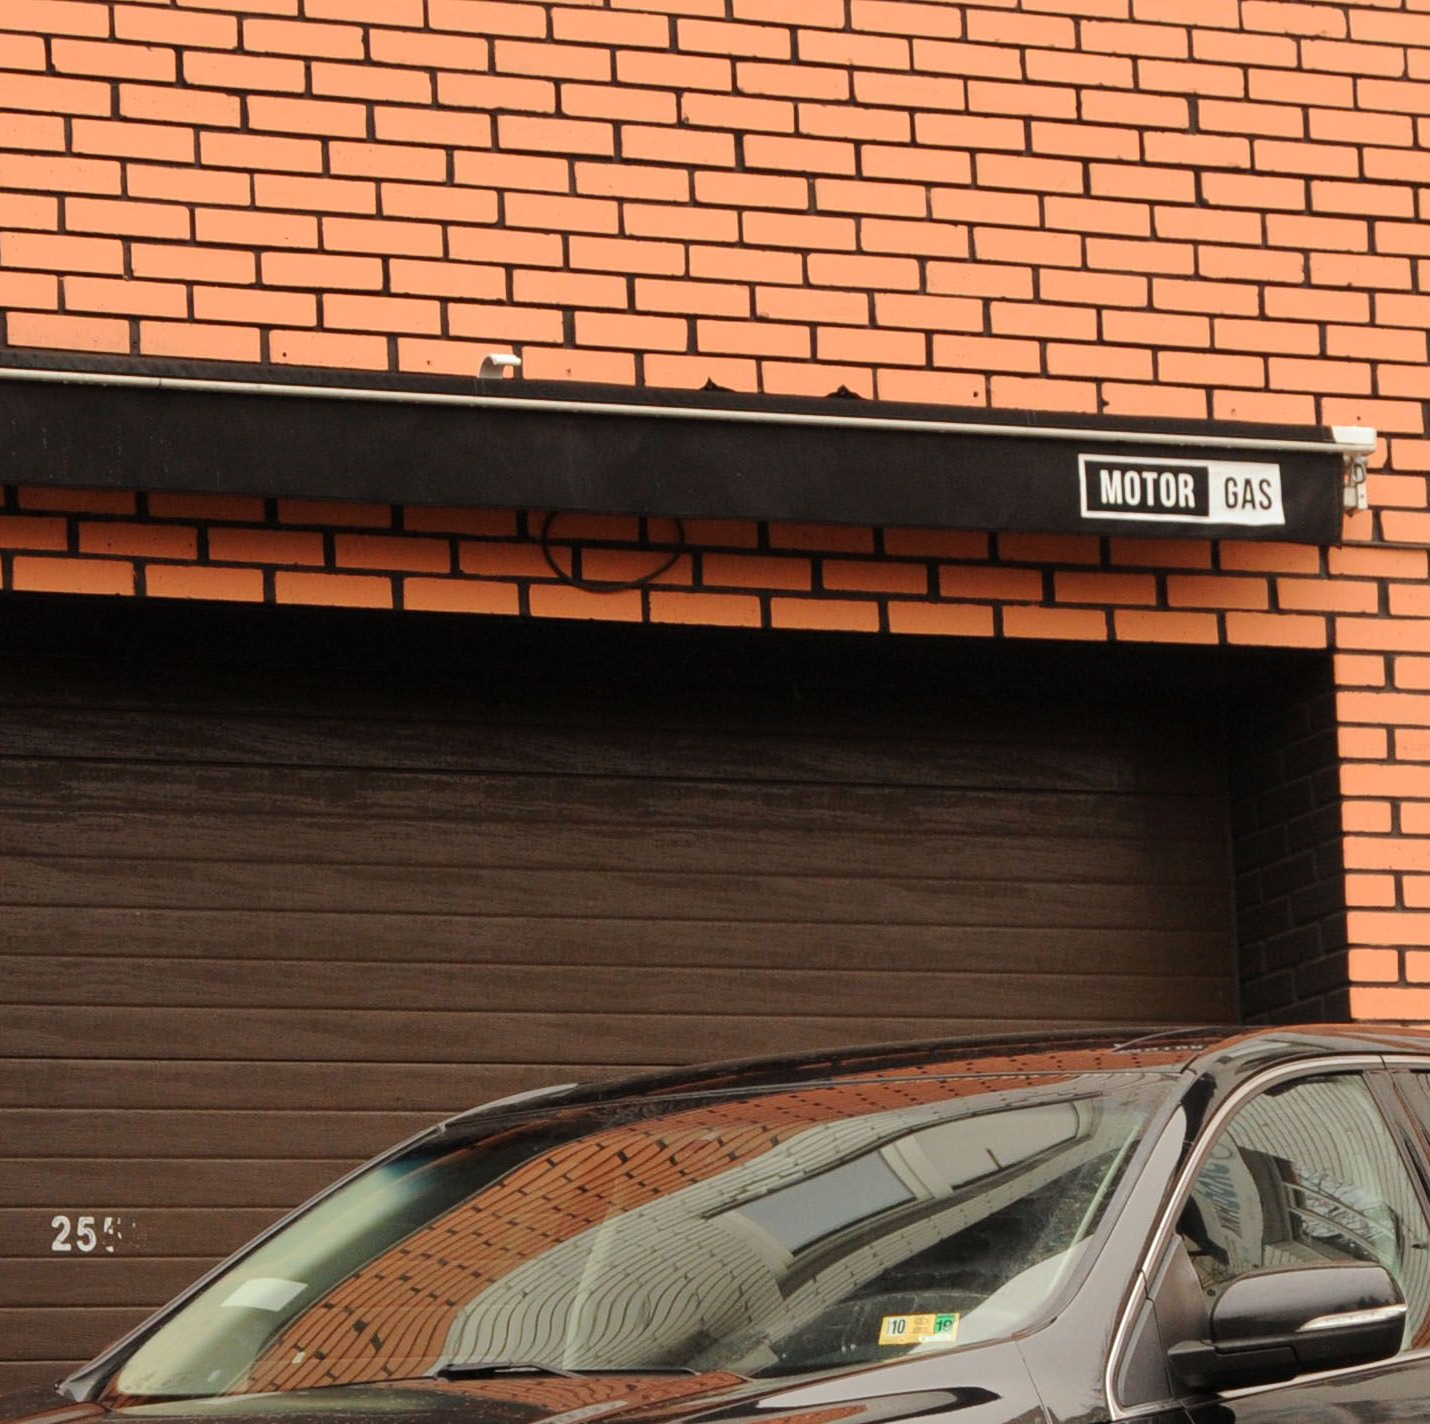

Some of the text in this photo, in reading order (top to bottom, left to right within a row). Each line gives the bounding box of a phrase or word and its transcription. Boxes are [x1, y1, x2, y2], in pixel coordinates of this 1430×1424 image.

[1099, 468, 1273, 510] MOTOR GAS
[892, 1318, 906, 1335] 10
[935, 1319, 953, 1333] 19
